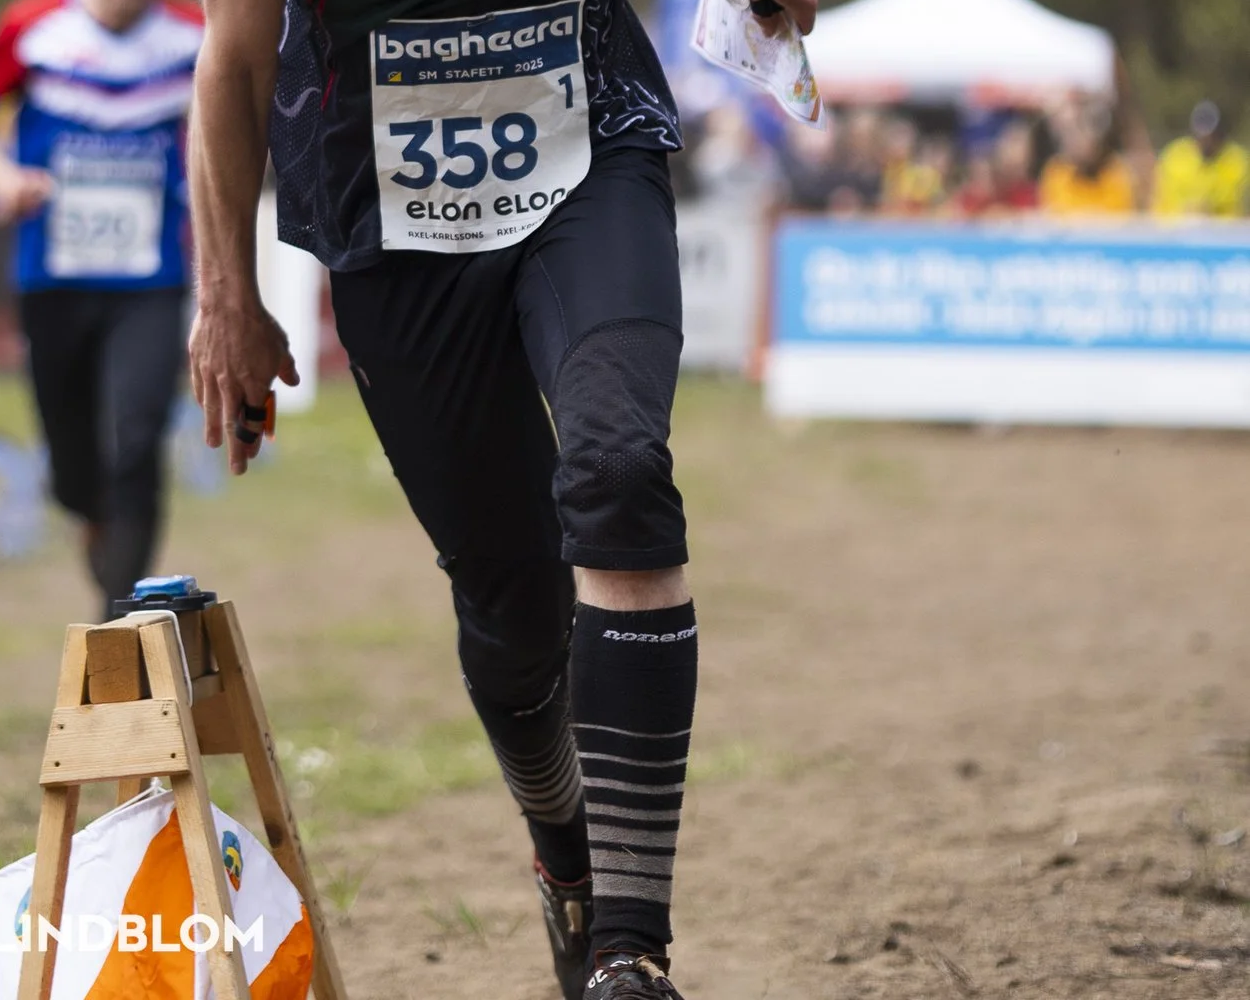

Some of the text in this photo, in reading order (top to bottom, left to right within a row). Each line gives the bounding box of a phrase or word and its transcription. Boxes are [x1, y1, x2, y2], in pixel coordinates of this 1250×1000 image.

[378, 14, 574, 62] bagheera
[418, 57, 545, 81] SM STAFETT 2025
[558, 72, 575, 109] 1
[388, 111, 539, 190] 358
[407, 229, 485, 242] AXEL-KARLSSONS
